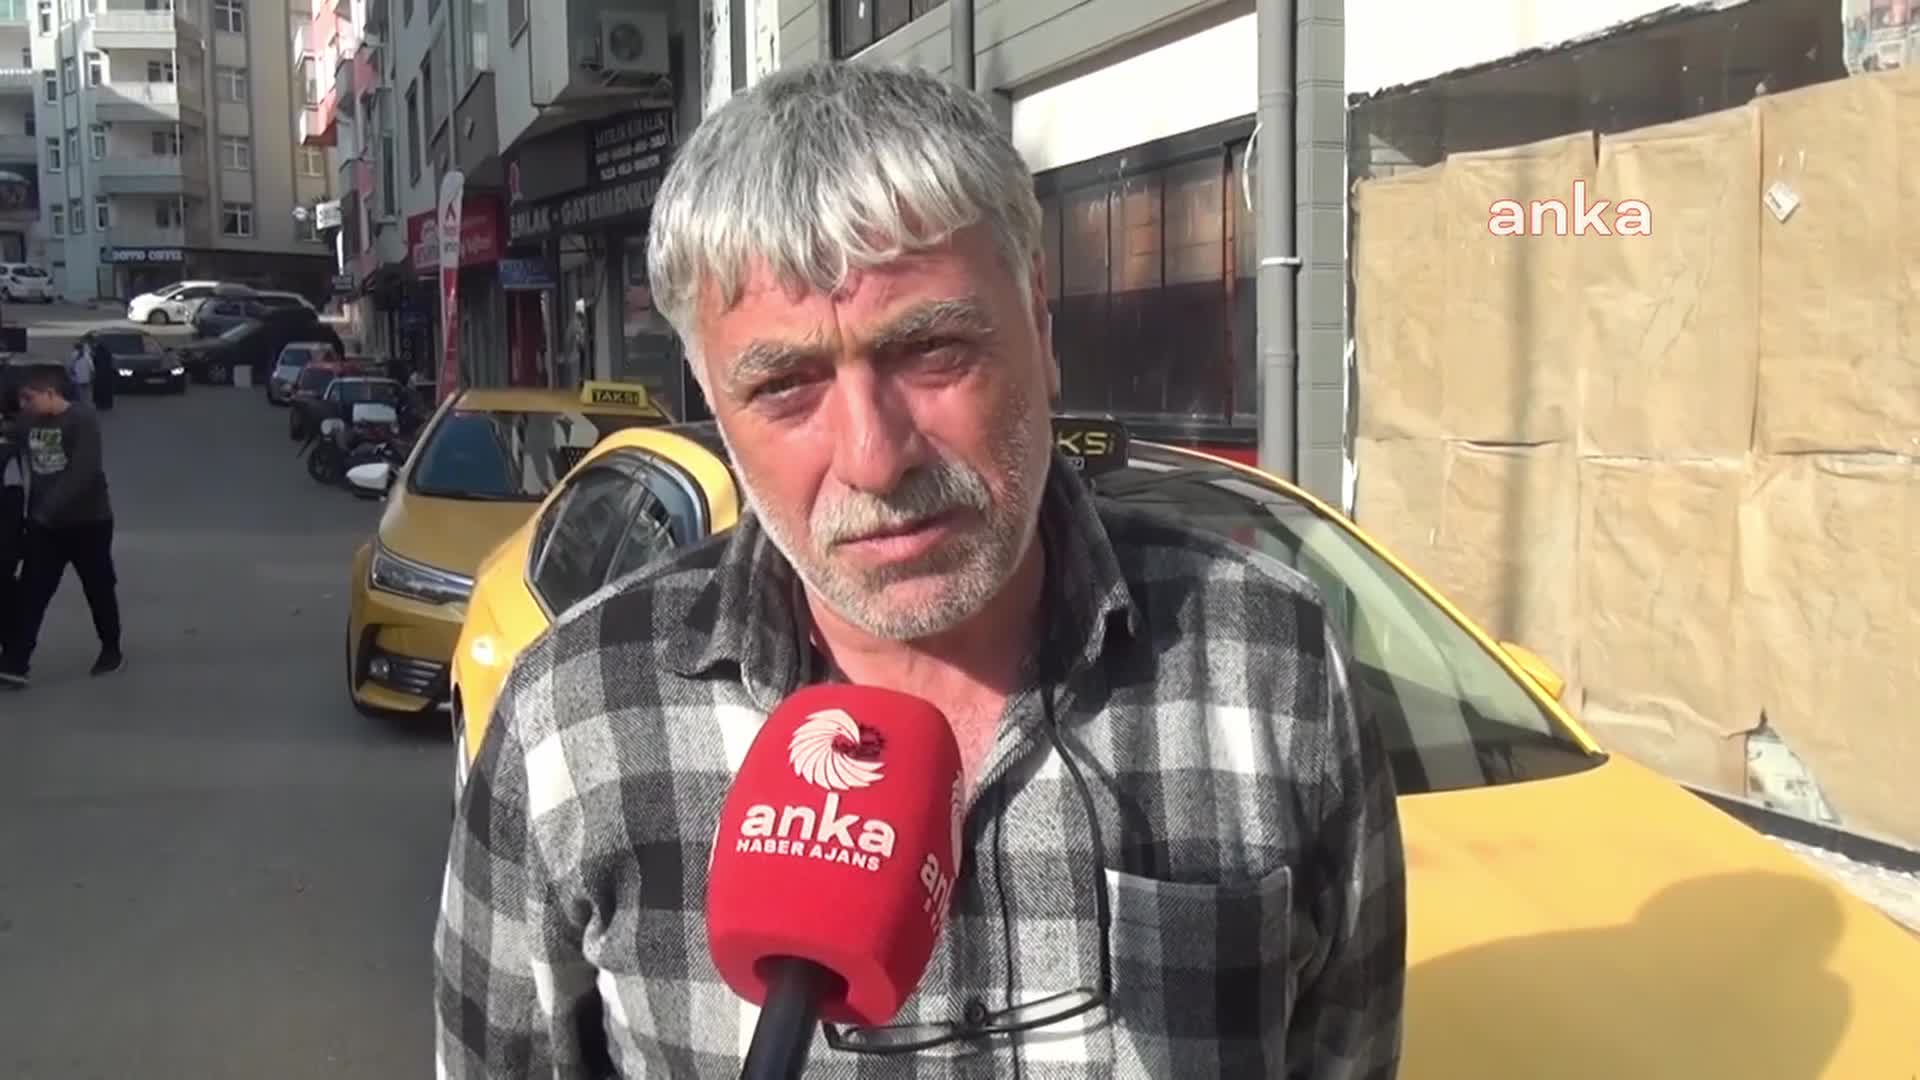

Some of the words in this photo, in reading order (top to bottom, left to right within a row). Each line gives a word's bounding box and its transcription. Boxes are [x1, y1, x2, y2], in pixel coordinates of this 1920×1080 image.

[740, 792, 895, 857] anka
[736, 839, 805, 857] HABER
[809, 844, 880, 872] AJANS
